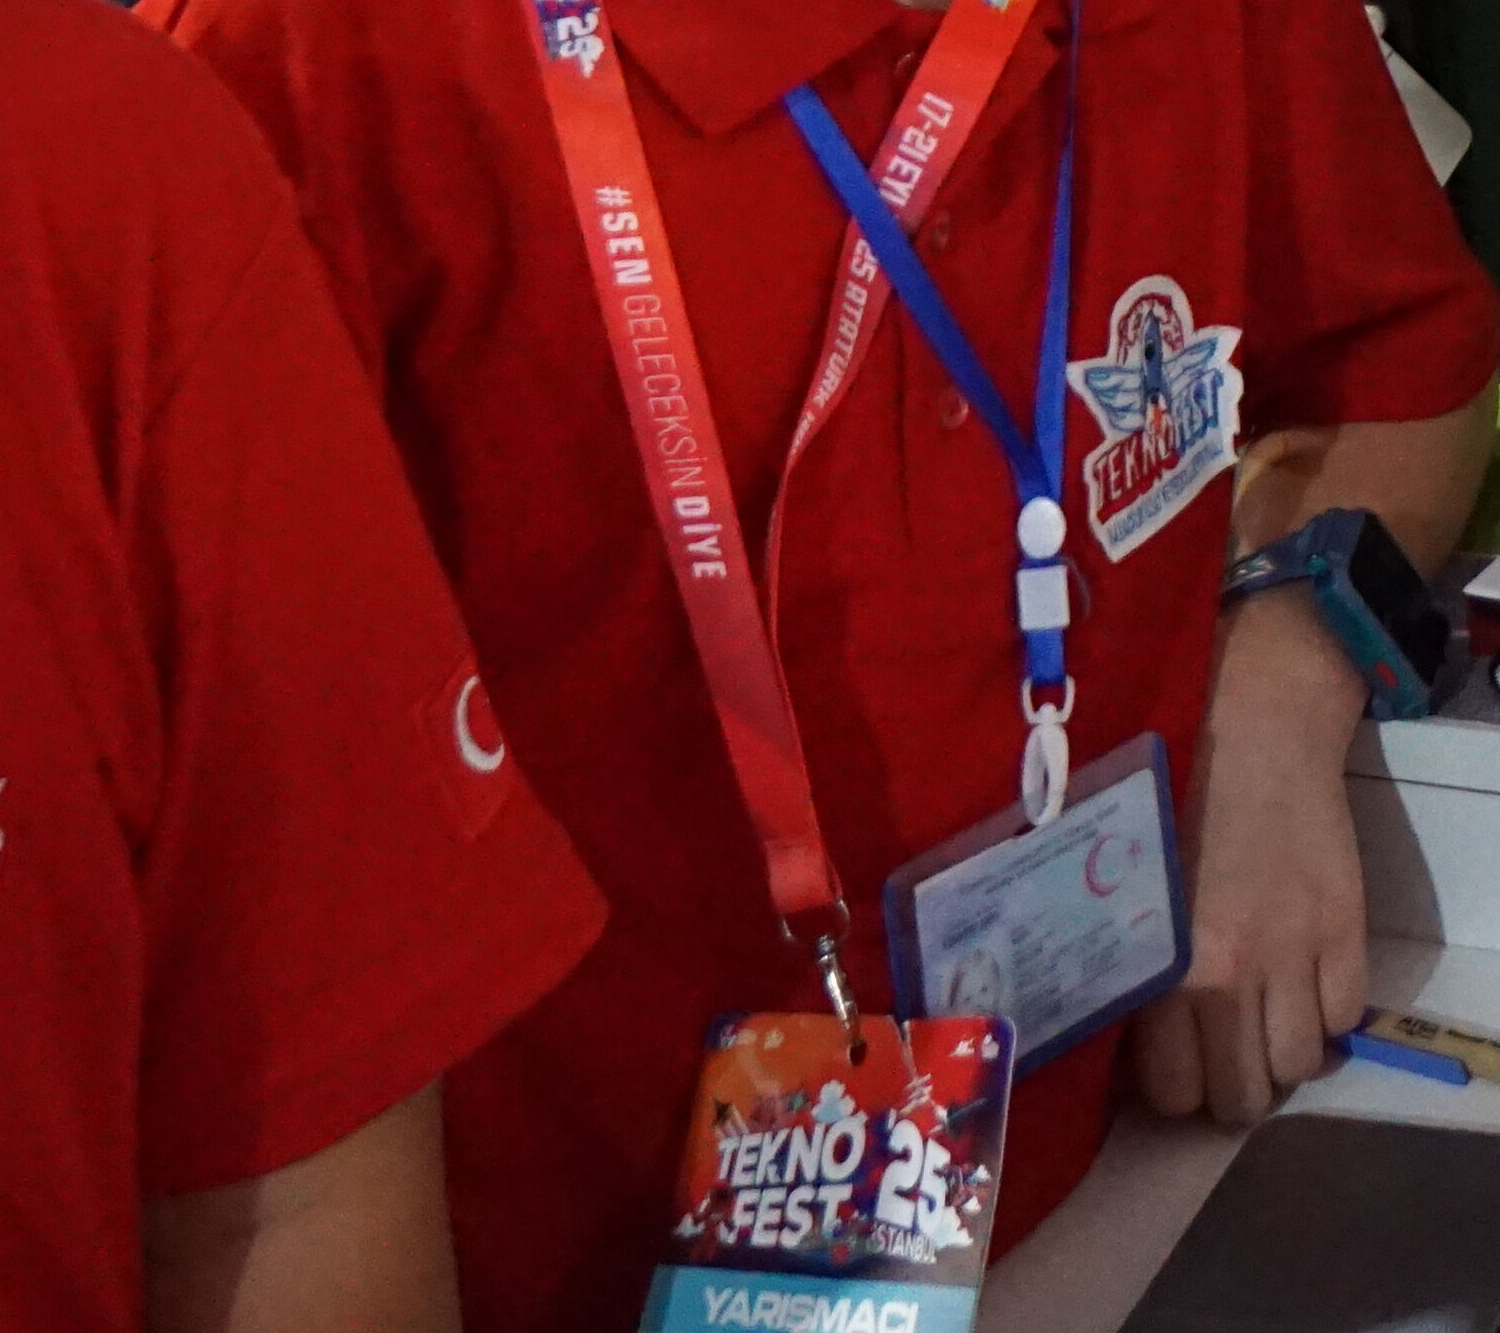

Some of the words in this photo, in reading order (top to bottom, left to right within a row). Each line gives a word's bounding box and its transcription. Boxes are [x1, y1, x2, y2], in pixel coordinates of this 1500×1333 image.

[717, 1112, 868, 1186] TEKNO
[874, 1118, 952, 1242] 25
[720, 1183, 853, 1249] FEST
